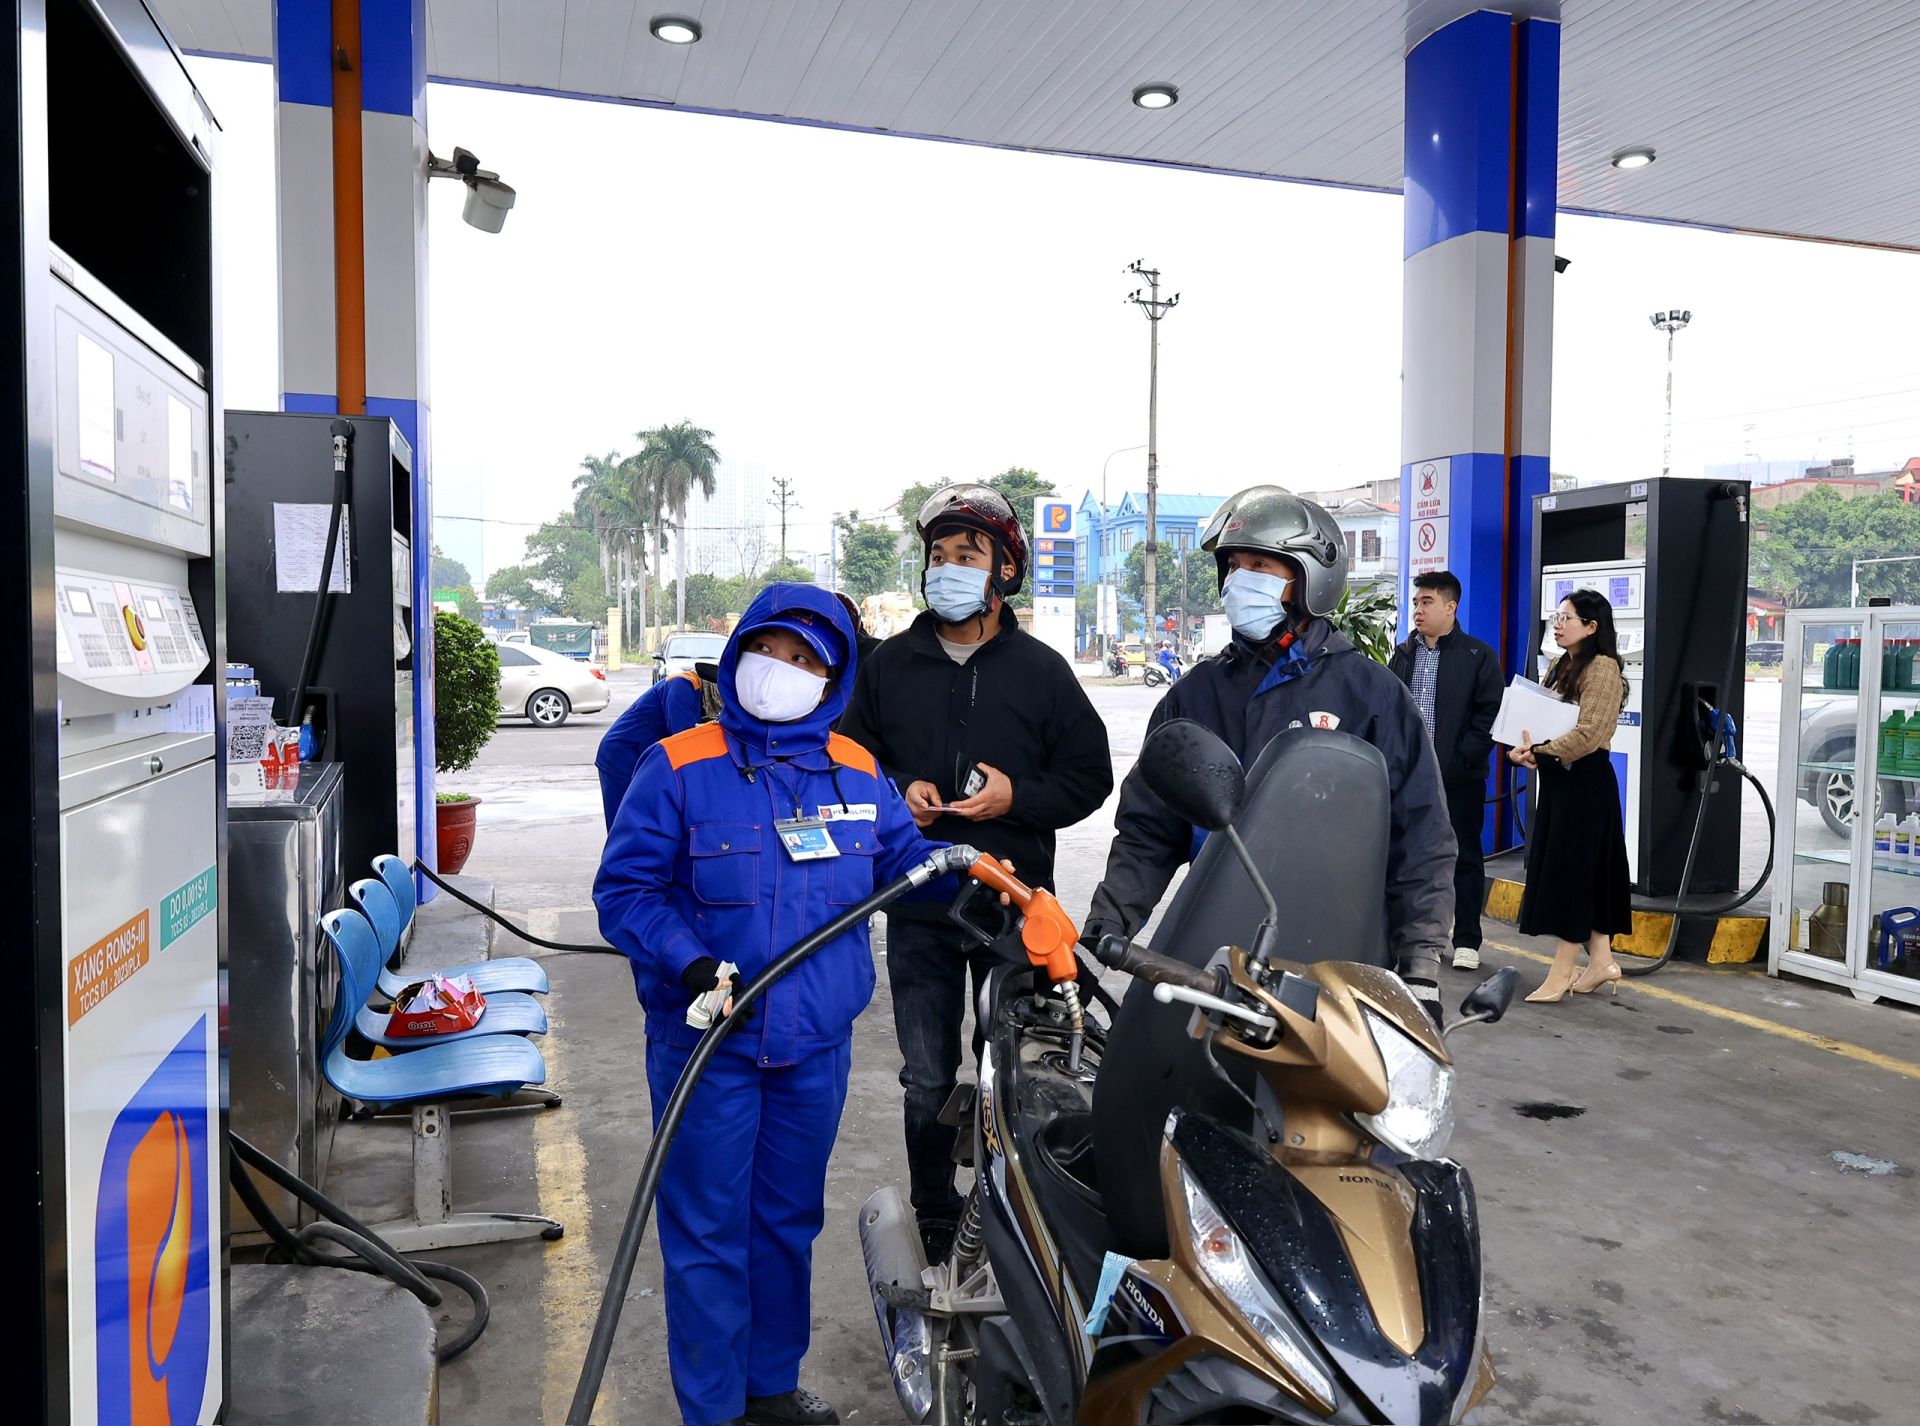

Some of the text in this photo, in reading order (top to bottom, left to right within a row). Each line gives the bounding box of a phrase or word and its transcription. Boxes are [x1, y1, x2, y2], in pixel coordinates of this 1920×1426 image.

[1426, 508, 1439, 516] FIRE
[170, 874, 209, 920] DO 0,001S-V
[171, 917, 182, 940] TCCS
[74, 918, 145, 994] XĂNG RON95-III
[79, 984, 100, 1015] TCCS
[100, 976, 108, 999] 01
[113, 951, 141, 987] 2023/PLX
[982, 1091, 1001, 1154] RSX
[1339, 1175, 1394, 1192] HONDA
[1125, 1278, 1165, 1334] HONDA
